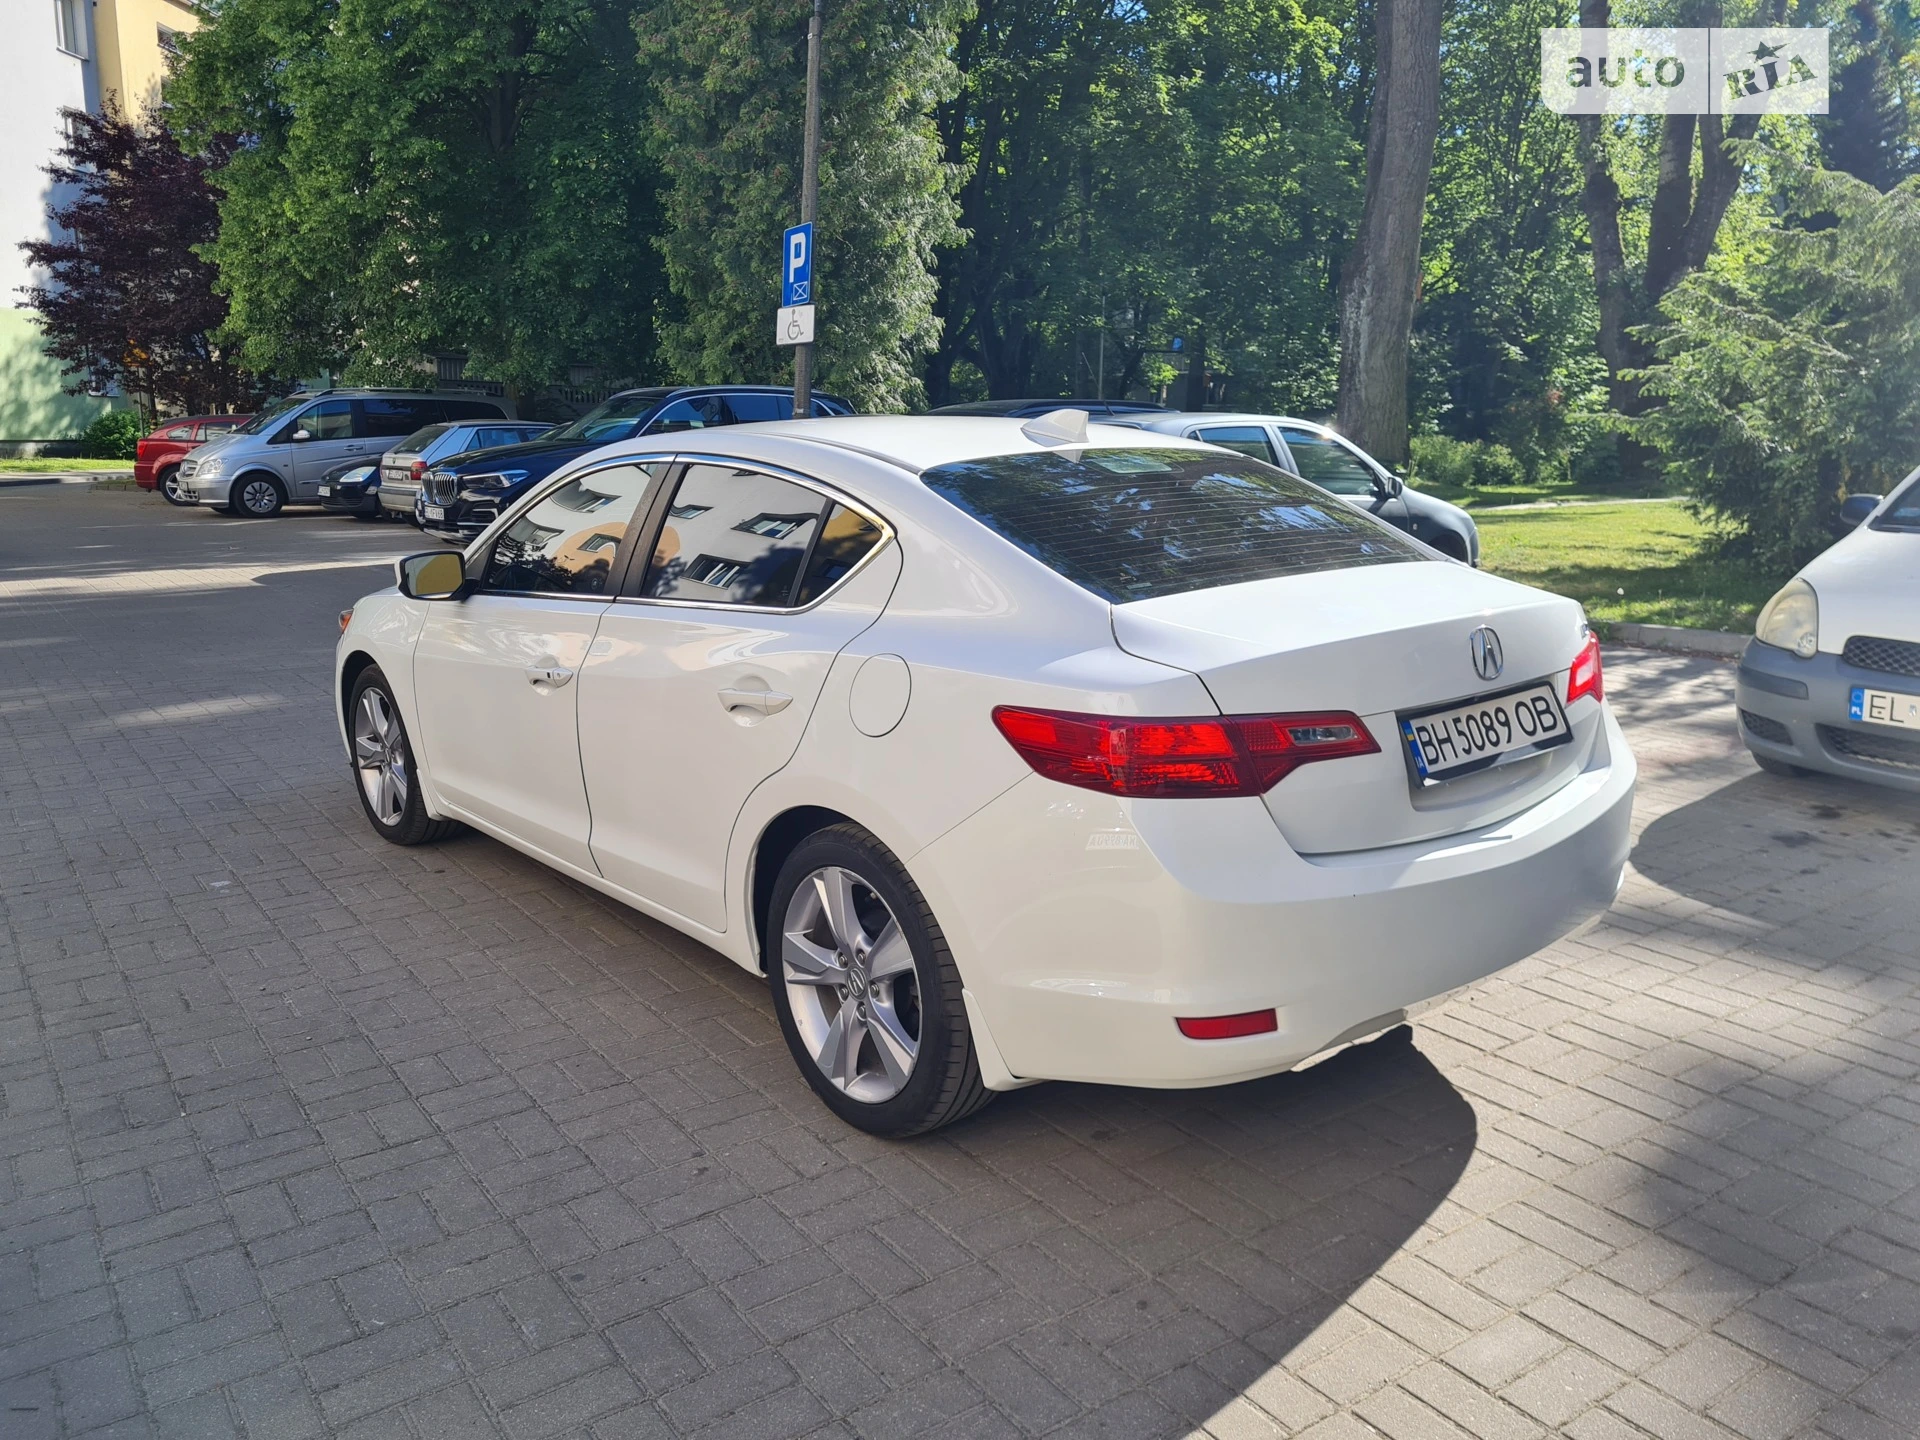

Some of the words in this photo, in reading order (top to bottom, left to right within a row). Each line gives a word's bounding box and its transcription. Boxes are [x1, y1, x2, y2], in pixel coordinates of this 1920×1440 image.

[789, 232, 806, 283] P
[1851, 706, 1862, 716] PL
[1869, 694, 1904, 723] EL
[1415, 720, 1459, 766] BH
[1452, 706, 1512, 755] 5089
[1514, 695, 1558, 737] OB
